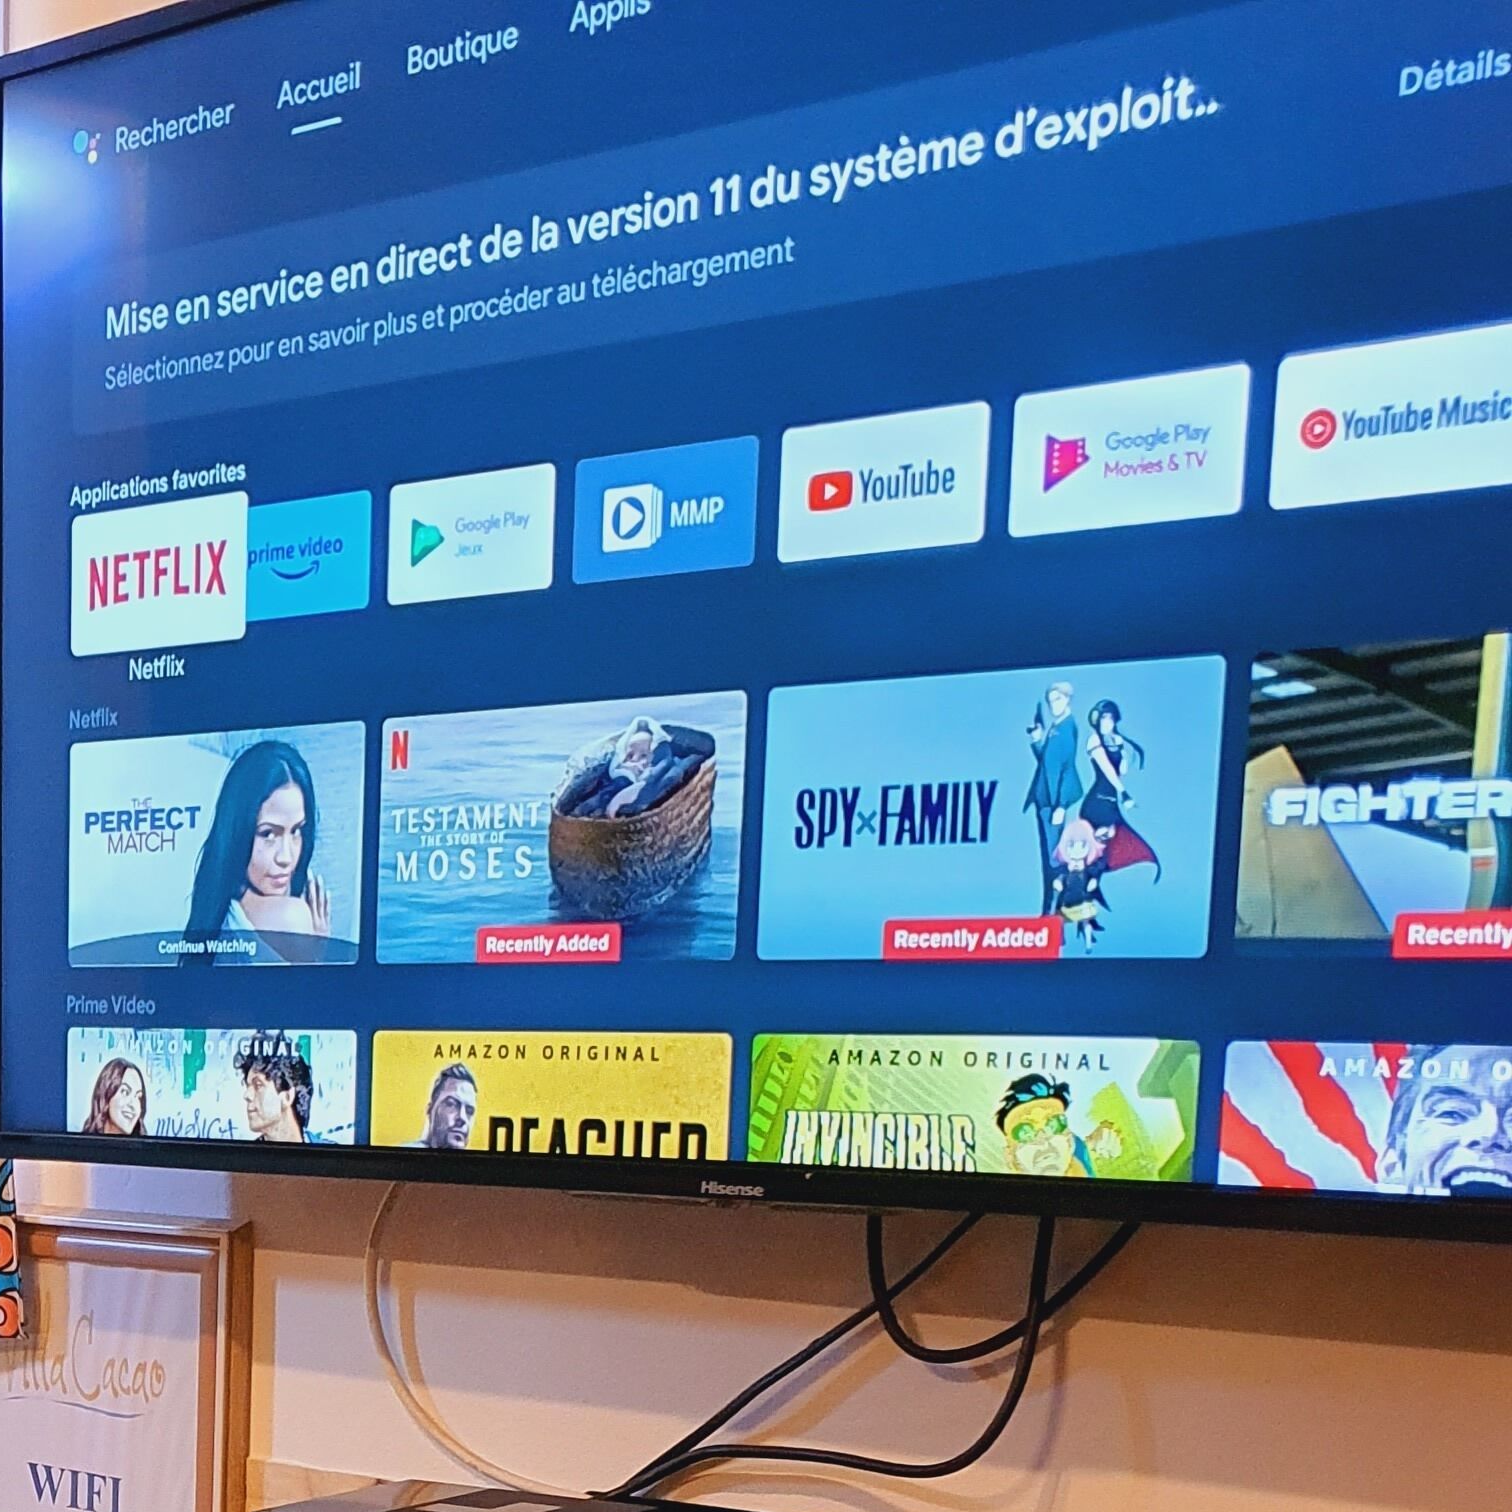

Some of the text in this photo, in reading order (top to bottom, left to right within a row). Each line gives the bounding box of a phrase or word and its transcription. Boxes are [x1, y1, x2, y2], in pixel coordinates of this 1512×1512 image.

[407, 24, 519, 75] Boutique
[277, 62, 361, 109] Accueil
[1399, 48, 1512, 97] Détails
[115, 102, 235, 153] Rechercher
[106, 301, 169, 341] Mise
[175, 294, 211, 325] en
[217, 269, 323, 317] service
[331, 261, 369, 294] en
[376, 232, 473, 285] direct
[479, 223, 524, 264] de
[530, 215, 560, 253] la
[567, 189, 699, 245] version
[709, 174, 741, 217] 11
[750, 163, 800, 208] du
[809, 129, 984, 203] système
[105, 235, 794, 390] Sélectionnez pour en savoir plus et procéder au téléchargement
[1342, 390, 1512, 440] YouTube Music
[1105, 423, 1211, 452] Google Play
[1104, 450, 1208, 479] Movies & TV
[70, 463, 246, 510] Applications favorites
[859, 460, 955, 503] YouTube
[454, 510, 530, 535] Google Play
[670, 496, 724, 528] MMP
[247, 535, 343, 571] prime video
[89, 540, 228, 611] NETFLIX
[128, 654, 186, 681] Netflix
[68, 706, 118, 730] Netflix
[1266, 777, 1512, 826] FIGHTER
[84, 805, 201, 834] PERFECT
[391, 801, 542, 834] TESTAMENT
[107, 831, 176, 855] MATCH
[420, 829, 506, 848] THE STORY OF
[396, 845, 534, 882] MOSES
[158, 939, 257, 956] Continue Watching
[485, 932, 610, 957] Recently Added
[893, 926, 1049, 952] Recently Added
[1407, 921, 1512, 950] Recently
[66, 995, 156, 1016] Prime Video
[115, 1039, 193, 1055] AMAZON
[434, 1043, 660, 1062] AMAZON ORIGINAL
[828, 1049, 1110, 1071] AMAZON ORIGINAL
[1319, 1057, 1470, 1081] AMAZON
[700, 1180, 765, 1197] Hisense
[72, 1309, 167, 1403] Cacao
